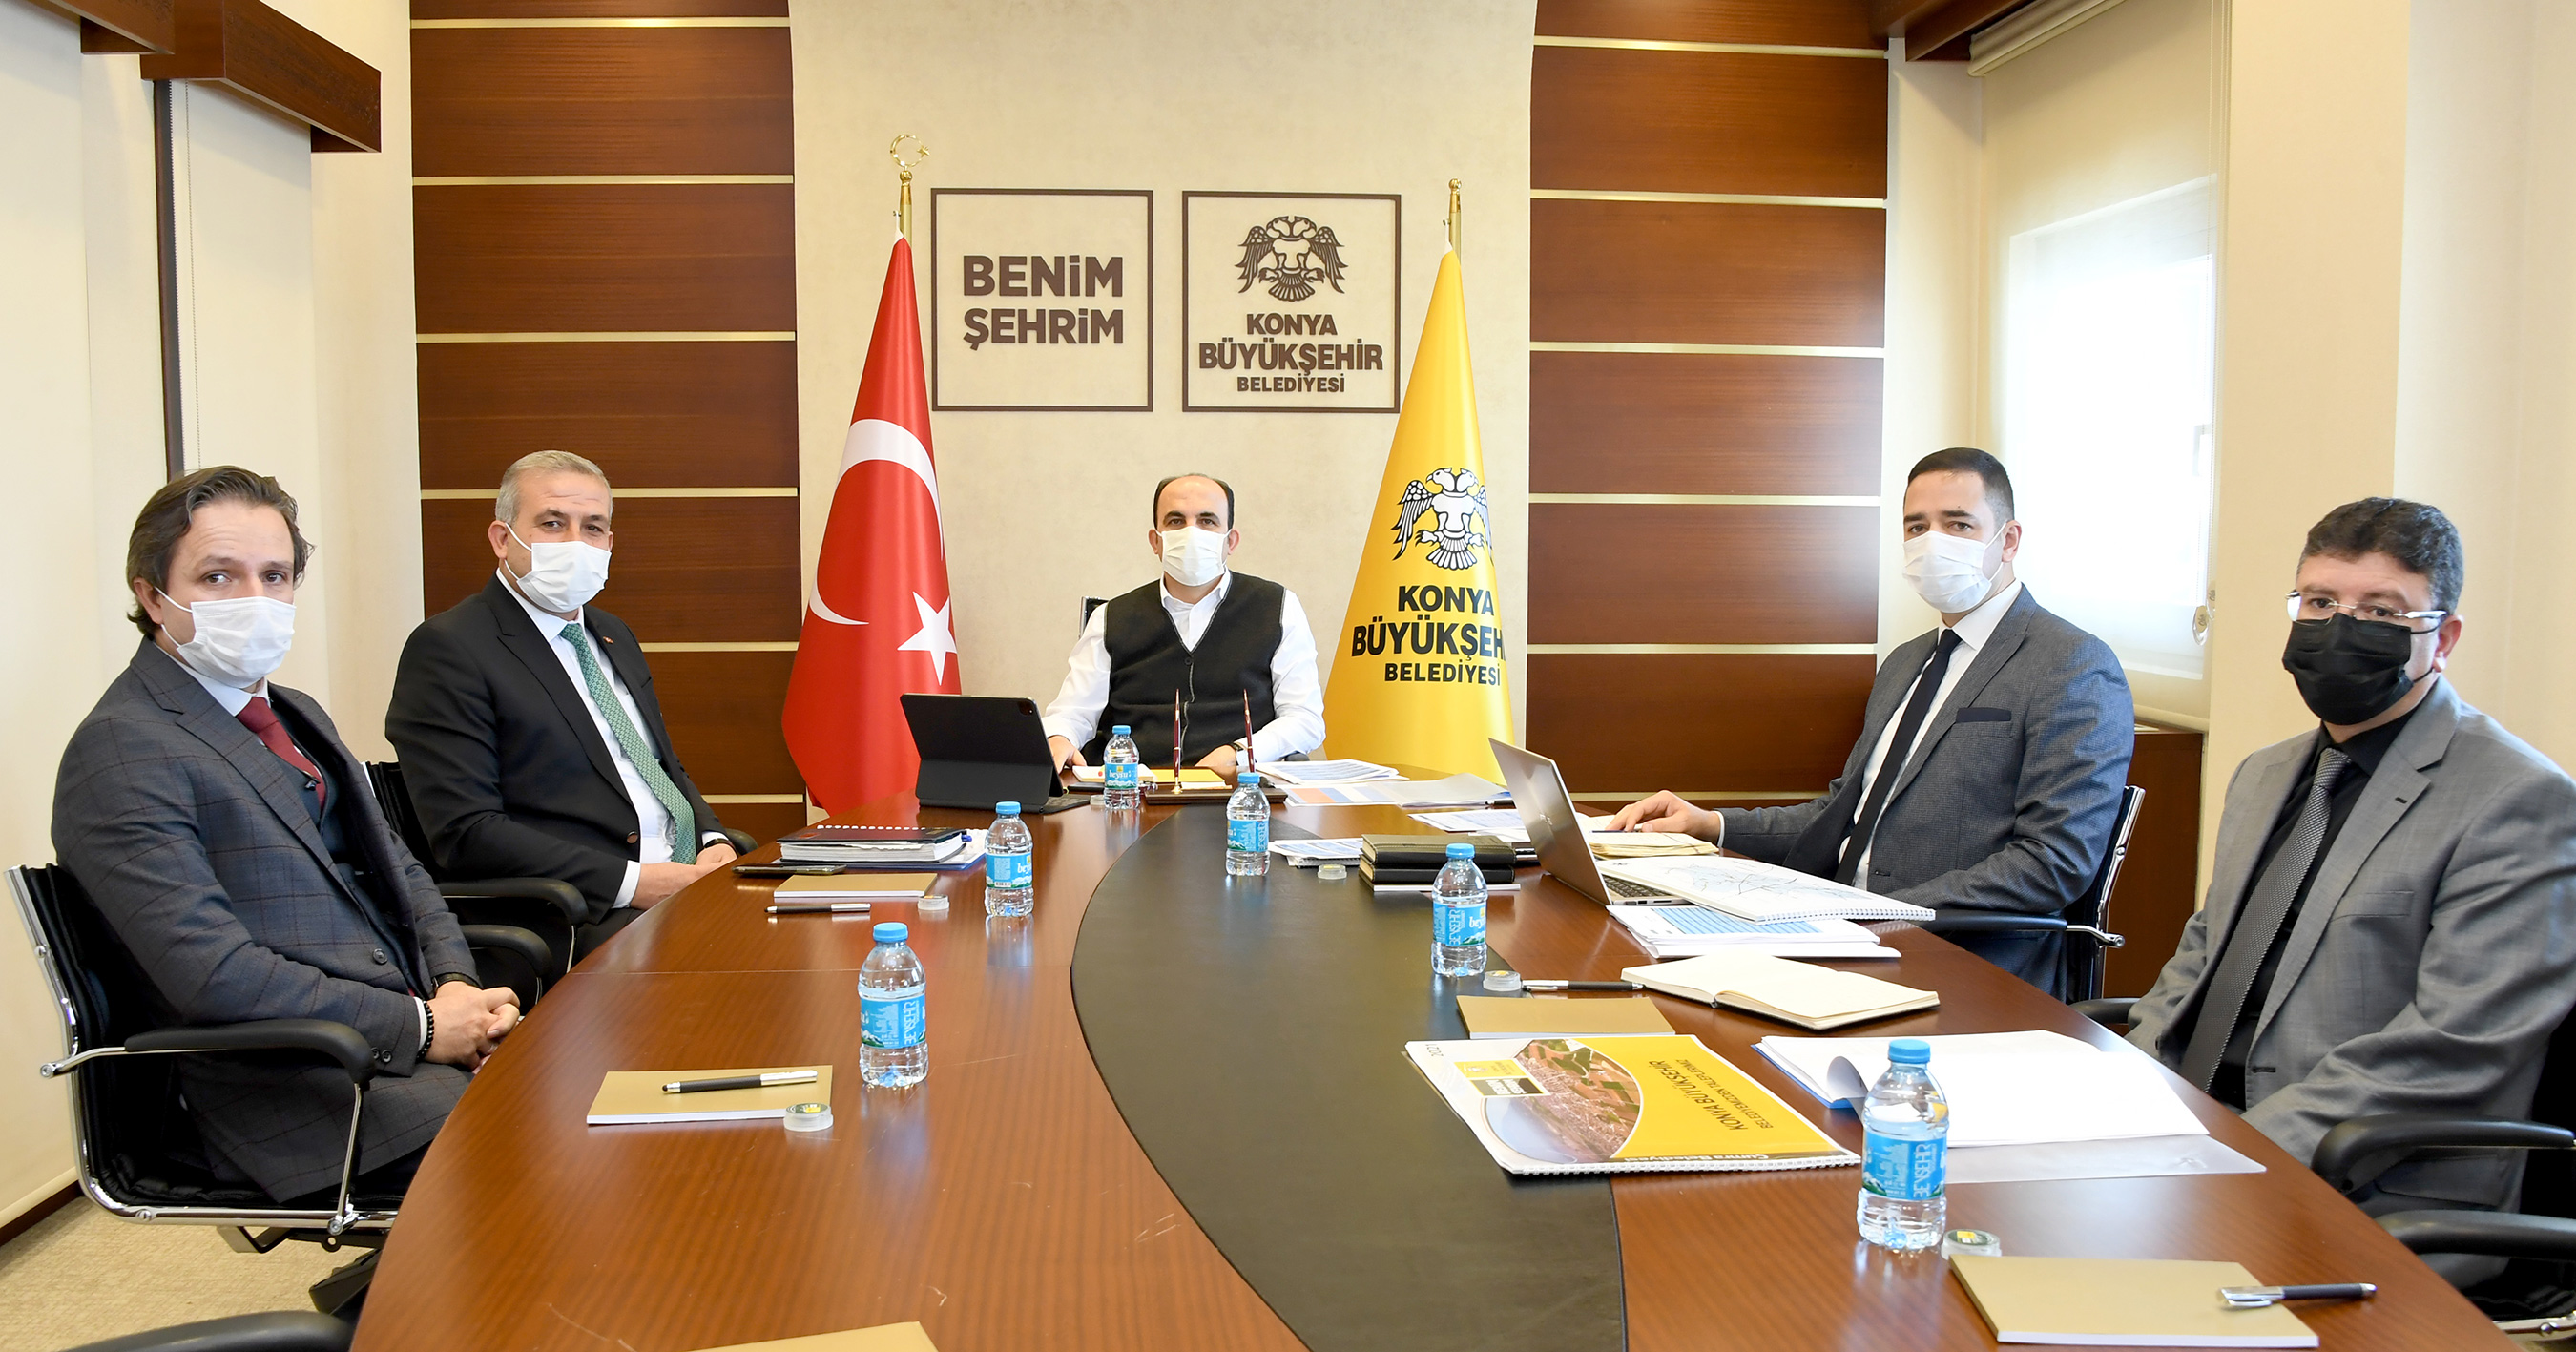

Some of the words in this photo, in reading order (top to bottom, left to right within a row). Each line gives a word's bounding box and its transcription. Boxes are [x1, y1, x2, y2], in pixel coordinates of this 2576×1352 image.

[963, 254, 1124, 298] BENİM
[962, 307, 1124, 351] ŞEHRİM
[1246, 313, 1337, 336] KONYA
[1199, 337, 1384, 376] BÜYÜKŞEHİR
[1237, 373, 1345, 393] BELEDİYESİ
[1398, 585, 1495, 616] KONYA
[1384, 659, 1501, 686] BELEDİYESİ
[1649, 1060, 1715, 1105] BÜYÜKŞEHİR
[1703, 1104, 1749, 1131] KONYA
